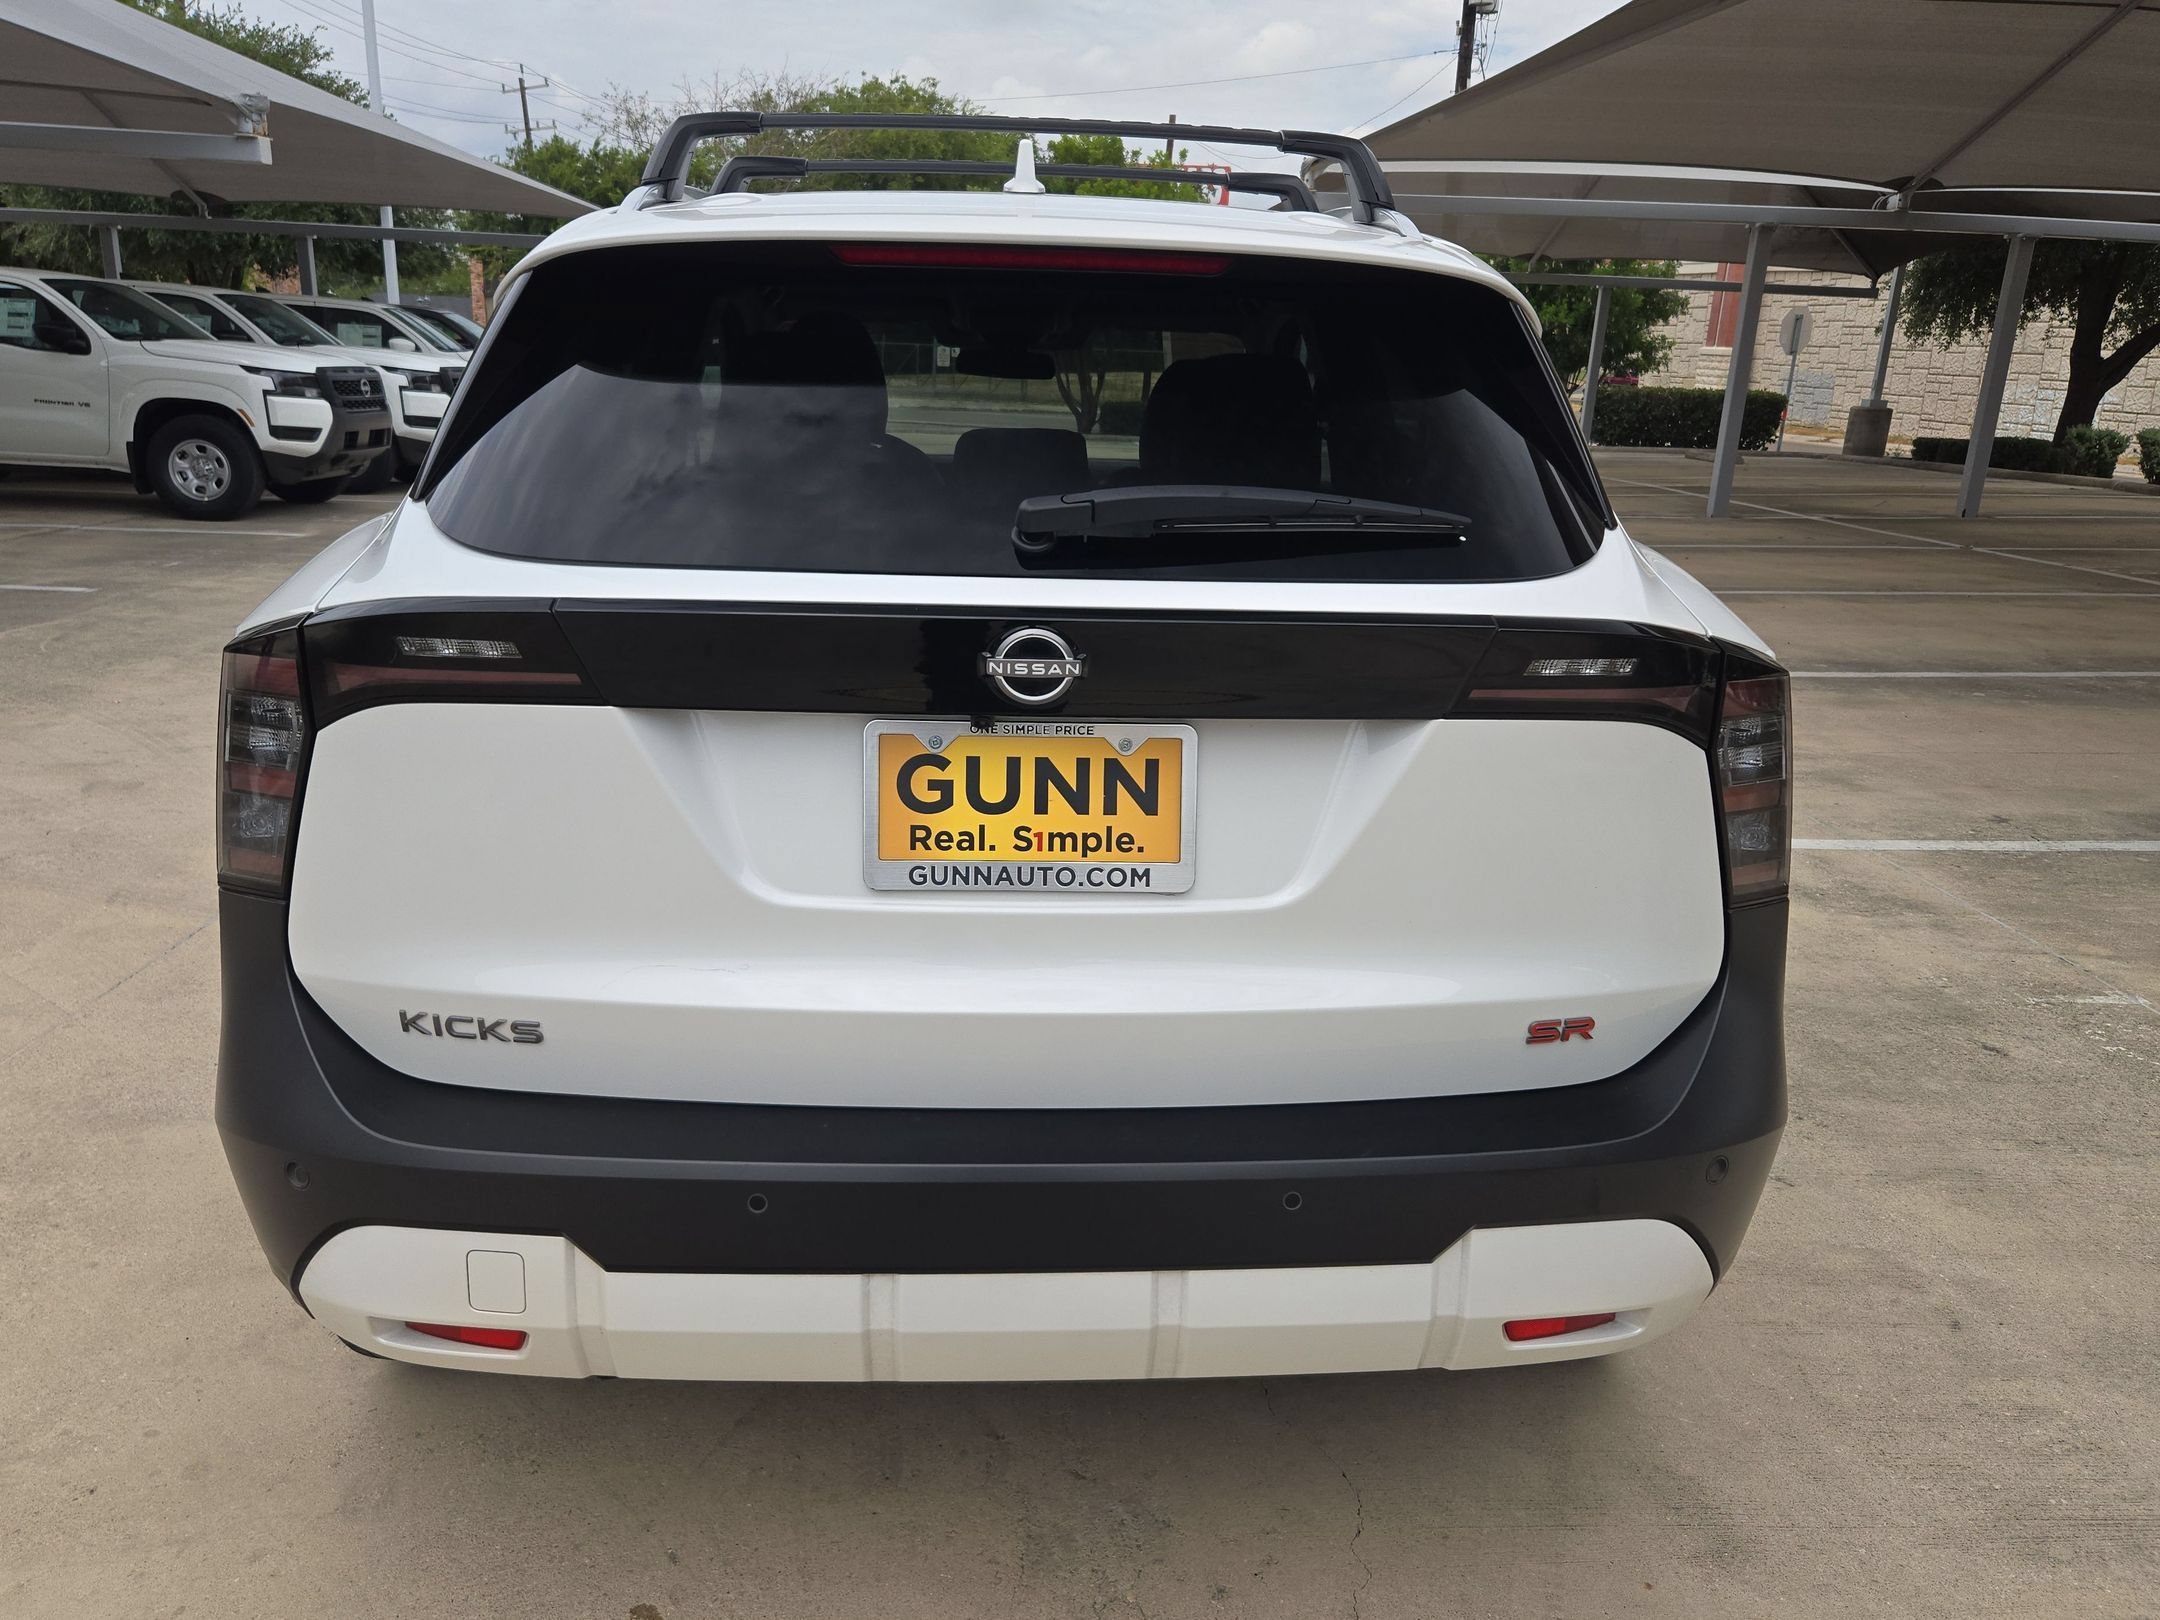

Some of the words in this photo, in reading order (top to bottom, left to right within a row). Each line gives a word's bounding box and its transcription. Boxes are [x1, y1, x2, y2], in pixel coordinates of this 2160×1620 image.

[988, 661, 1080, 675] NISSAN
[1003, 724, 1051, 735] SIMPLE
[1055, 725, 1095, 736] PRICE
[896, 753, 1160, 816] GUNN
[909, 824, 997, 852] Real.
[908, 865, 1151, 888] GUNNAUTO.COM
[398, 1008, 545, 1045] KICKS
[1525, 1016, 1596, 1045] SR
